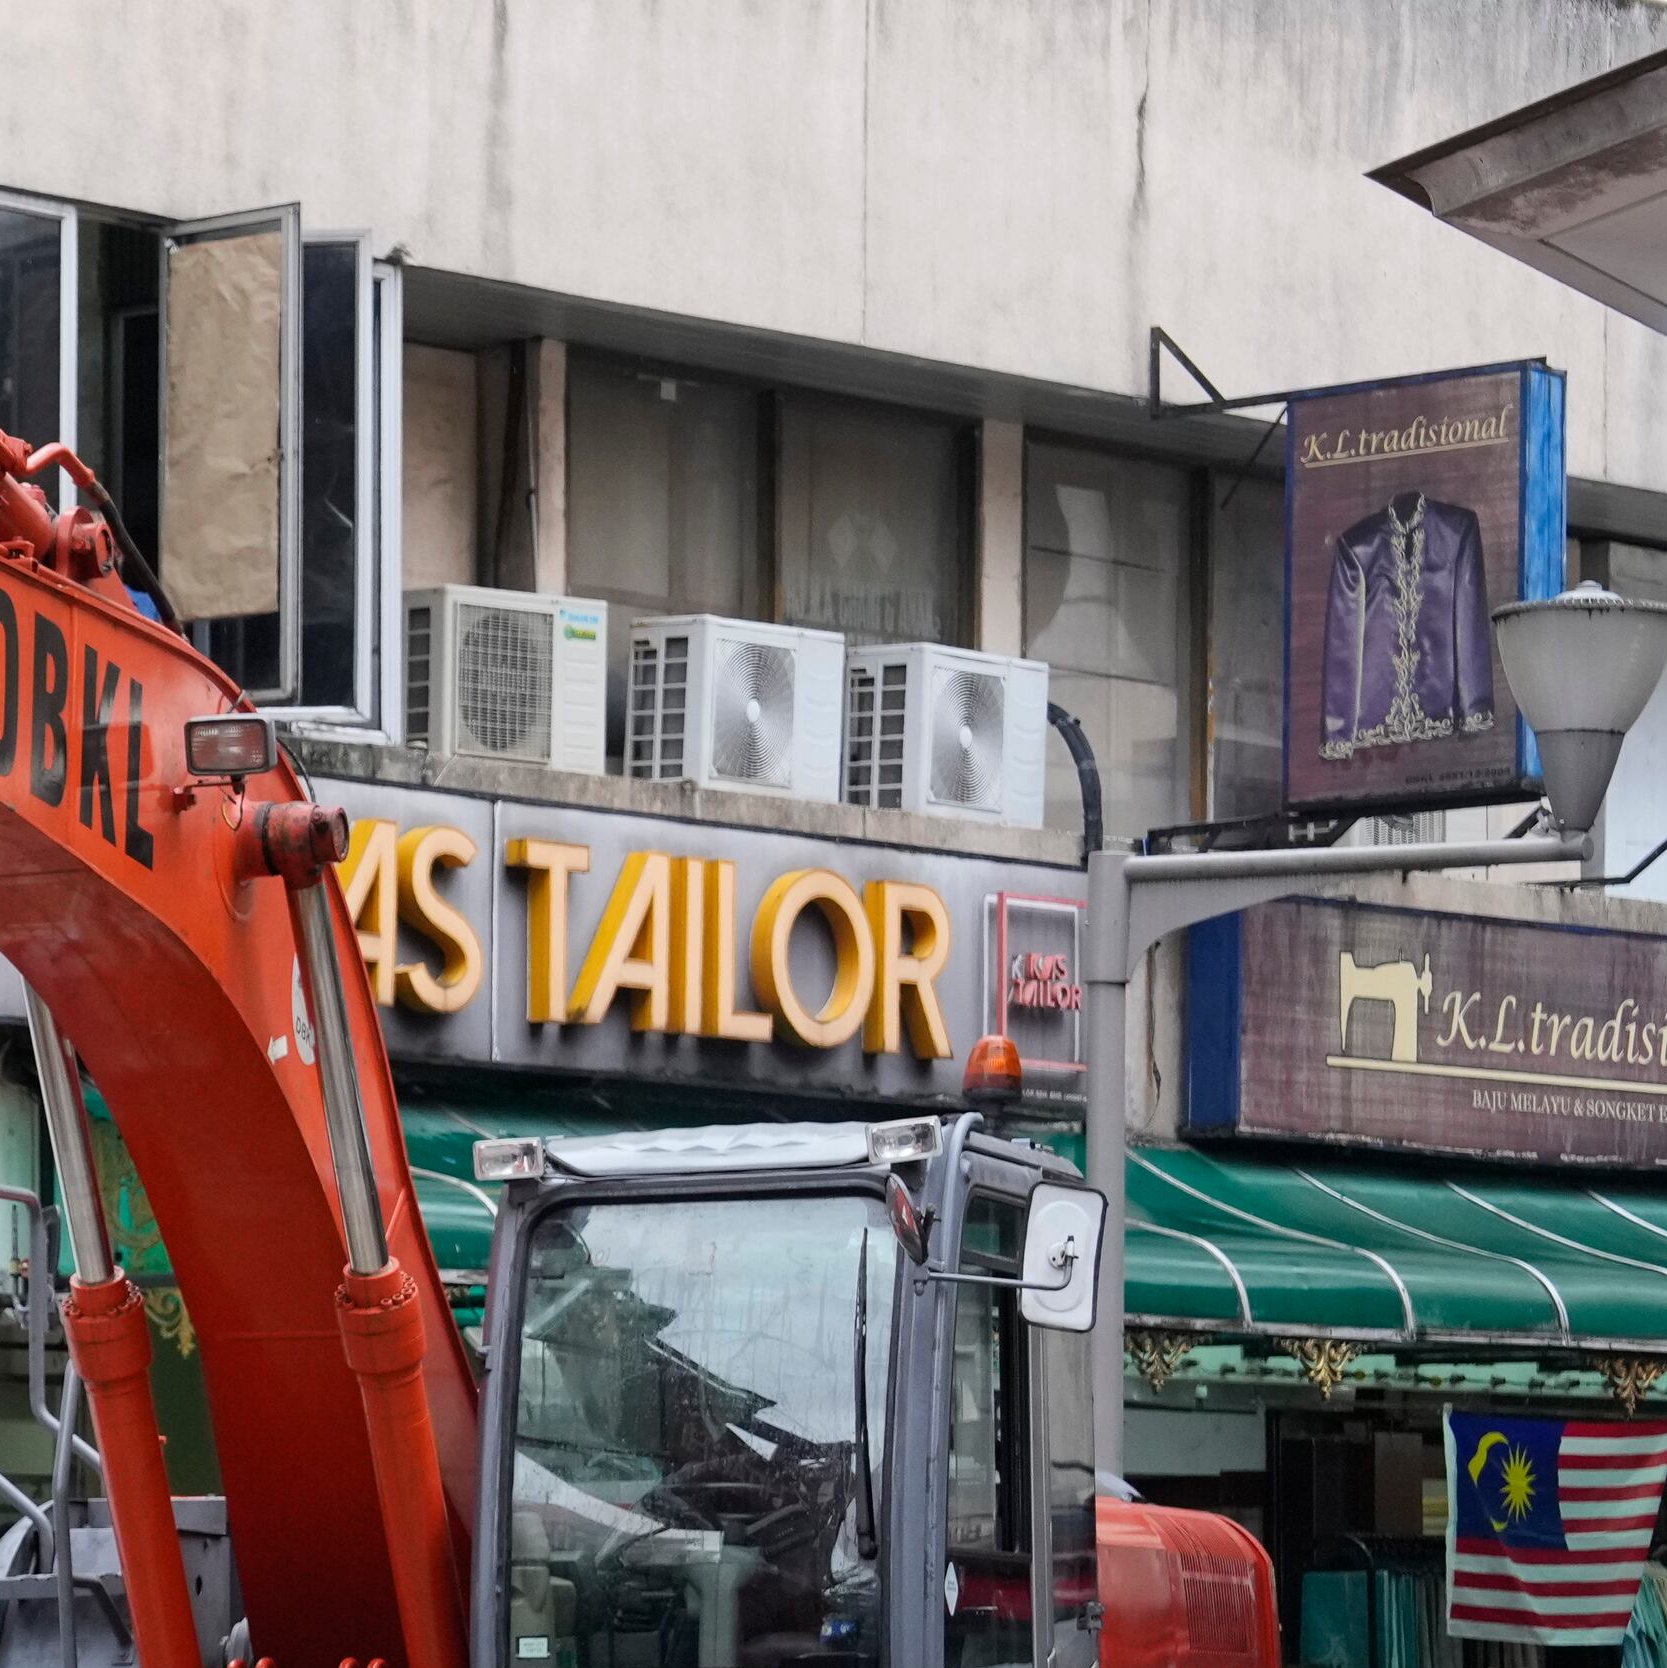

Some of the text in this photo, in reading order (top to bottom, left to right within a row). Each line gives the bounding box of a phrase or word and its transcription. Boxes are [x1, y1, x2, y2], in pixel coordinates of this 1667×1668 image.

[504, 837, 953, 1060] TAILOR
[1009, 978, 1085, 1013] TAILOR
[1472, 1088, 1508, 1114] BAJU
[1510, 1092, 1571, 1117] MELAYU
[1573, 1097, 1585, 1117] &
[1585, 1098, 1657, 1123] SONGKET
